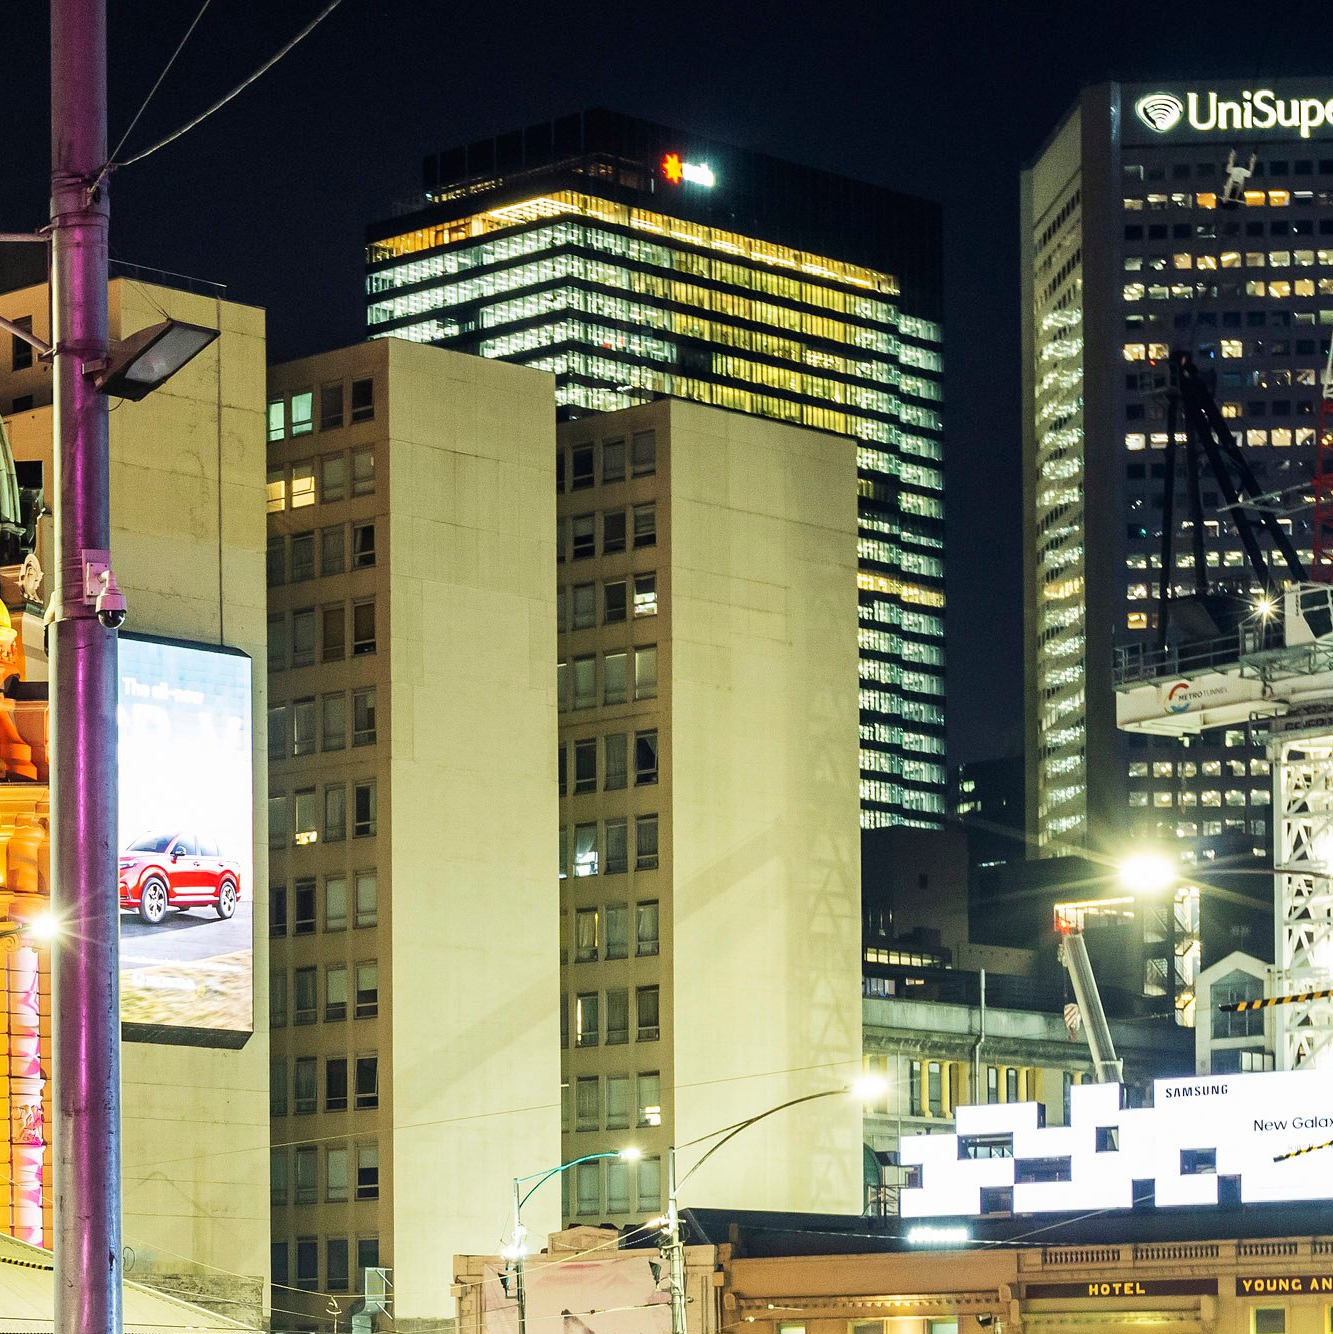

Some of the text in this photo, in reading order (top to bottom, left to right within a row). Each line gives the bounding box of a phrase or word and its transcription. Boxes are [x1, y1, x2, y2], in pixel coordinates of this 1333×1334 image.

[1165, 1084, 1229, 1099] SAMSUNG
[1253, 1119, 1288, 1132] New
[1088, 1281, 1146, 1296] HOTEL
[1242, 1278, 1302, 1292] YOUNG
